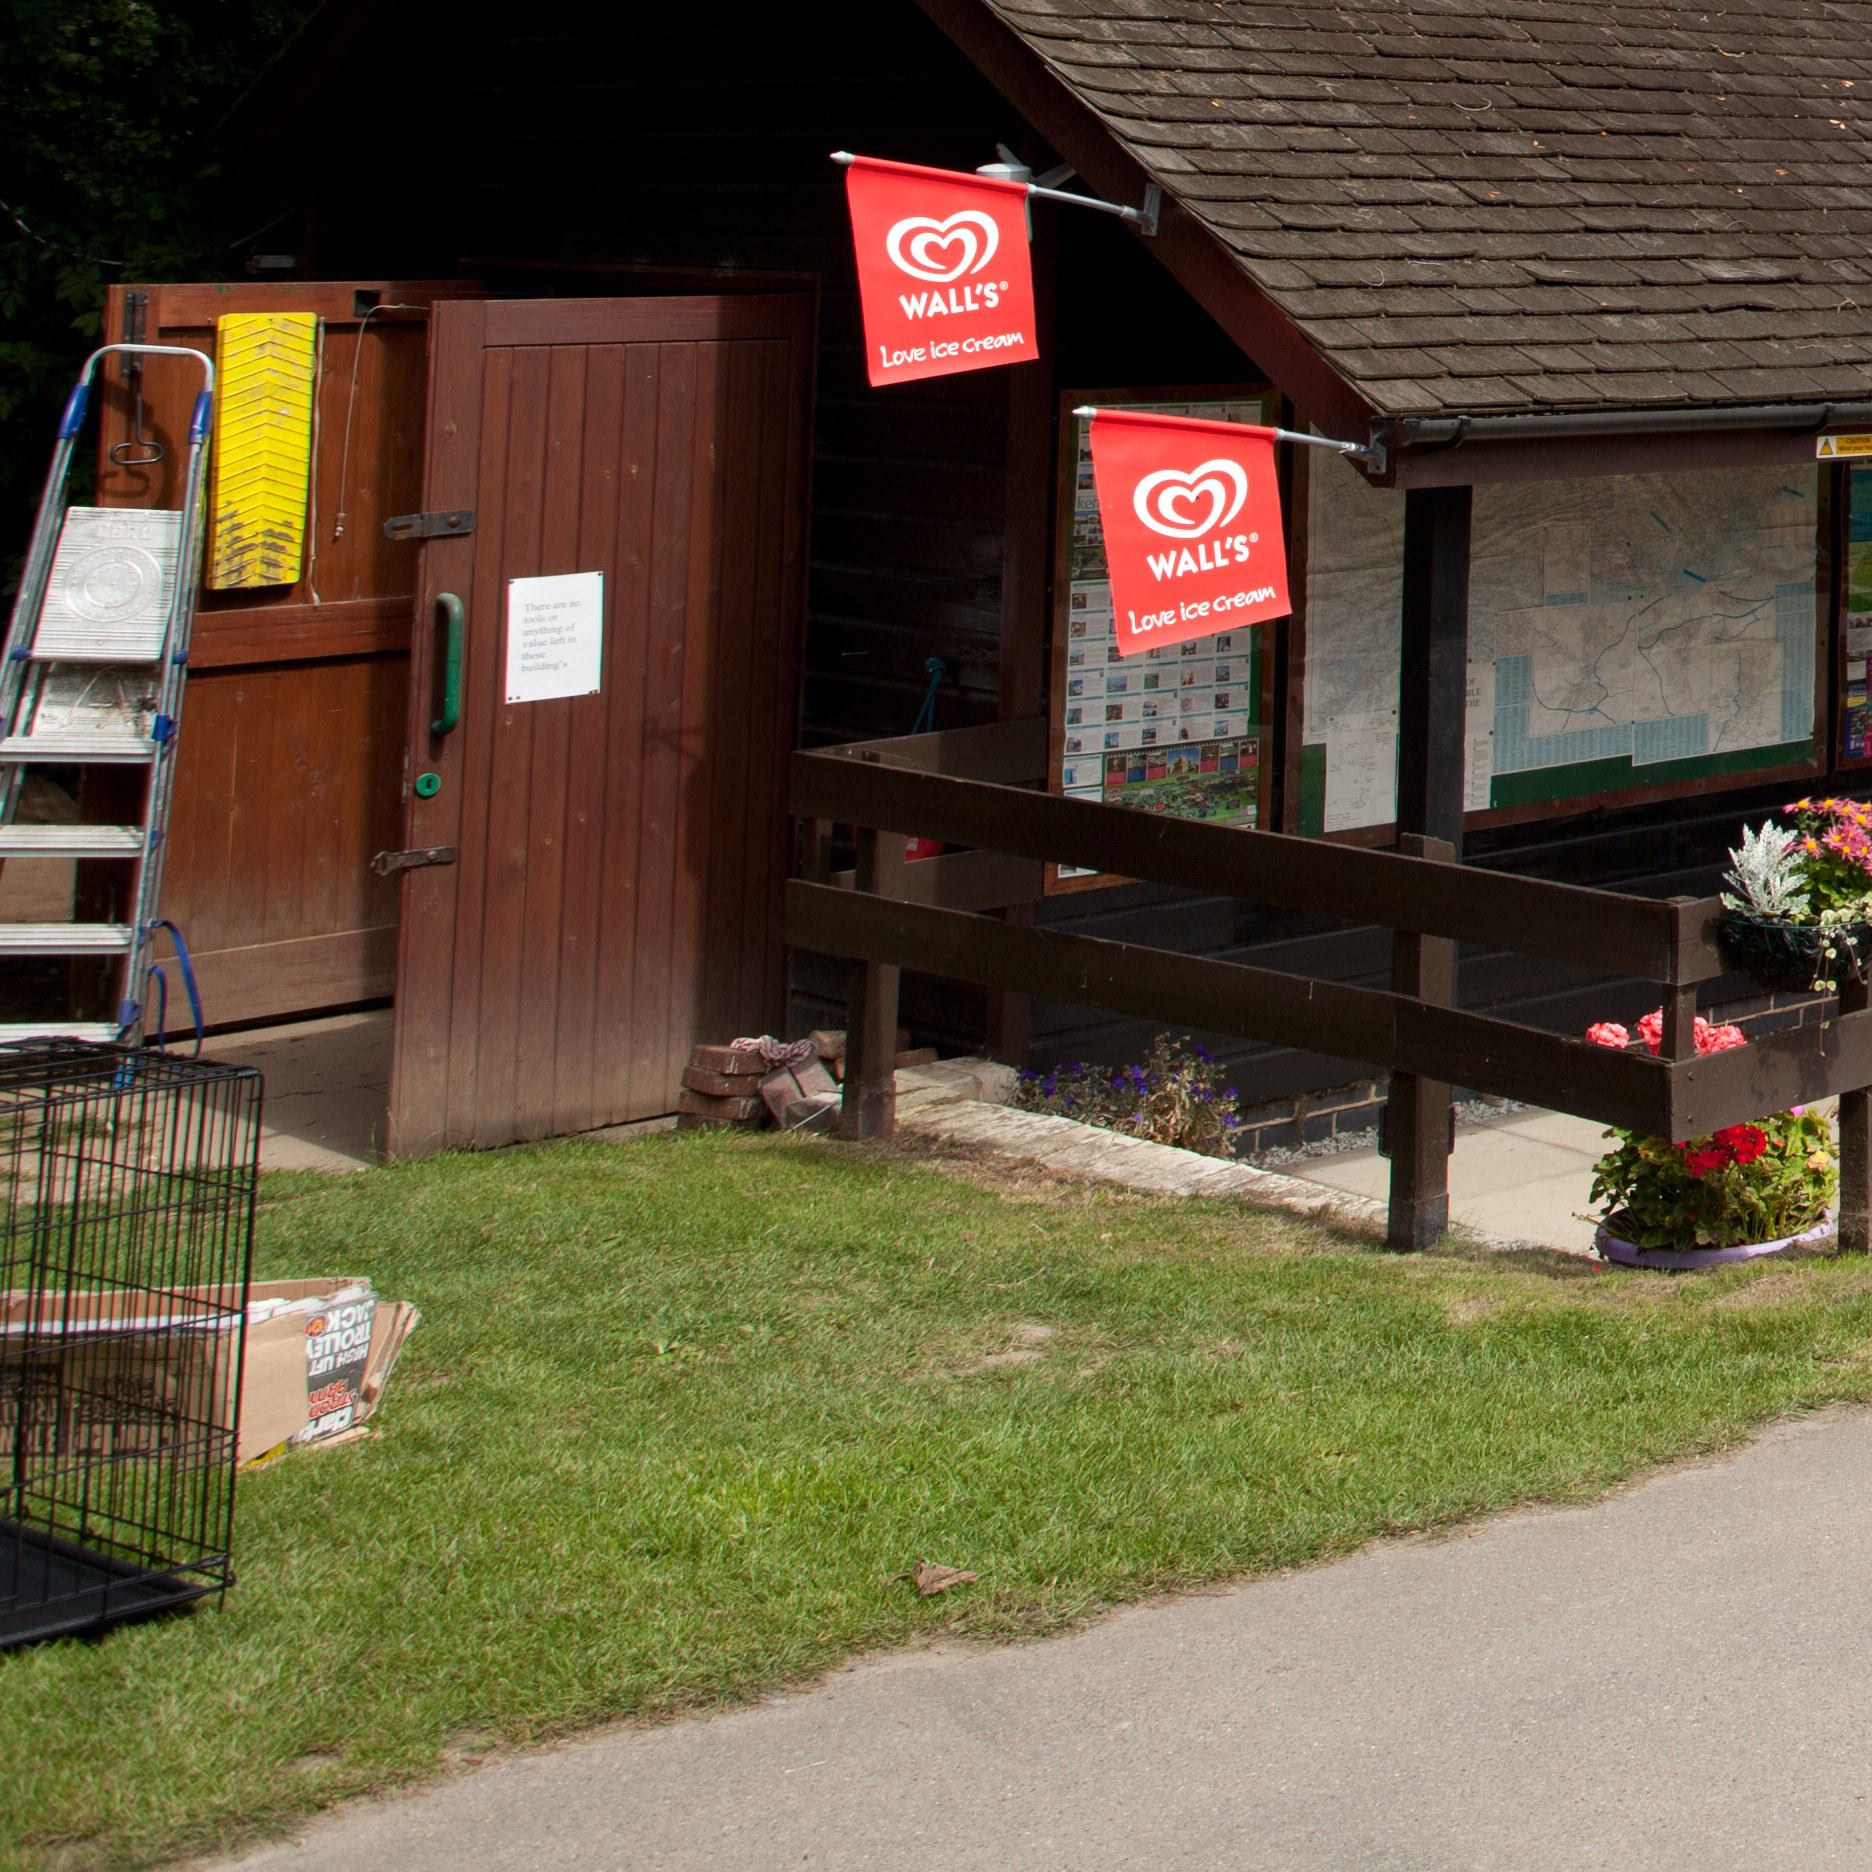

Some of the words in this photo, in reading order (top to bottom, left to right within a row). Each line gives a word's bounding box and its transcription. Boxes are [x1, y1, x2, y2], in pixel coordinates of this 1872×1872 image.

[898, 282, 1000, 320] WALL'S
[880, 345, 927, 368] Love
[930, 340, 960, 359] ice
[962, 332, 1024, 353] cream
[1146, 534, 1250, 582] WALL'S
[525, 602, 551, 612] There
[1128, 610, 1177, 635] Love
[1180, 601, 1210, 622] ice
[1213, 586, 1276, 611] cream
[523, 625, 563, 637] anything
[565, 623, 576, 631] of
[524, 615, 547, 624] tools
[523, 638, 548, 648] value
[550, 636, 565, 645] left
[522, 651, 546, 660] these
[522, 661, 568, 673] building's
[327, 1298, 376, 1332] JACK
[307, 1321, 371, 1359] TROLLEY
[309, 1354, 335, 1376] LIFT
[337, 1342, 369, 1367] HIGH
